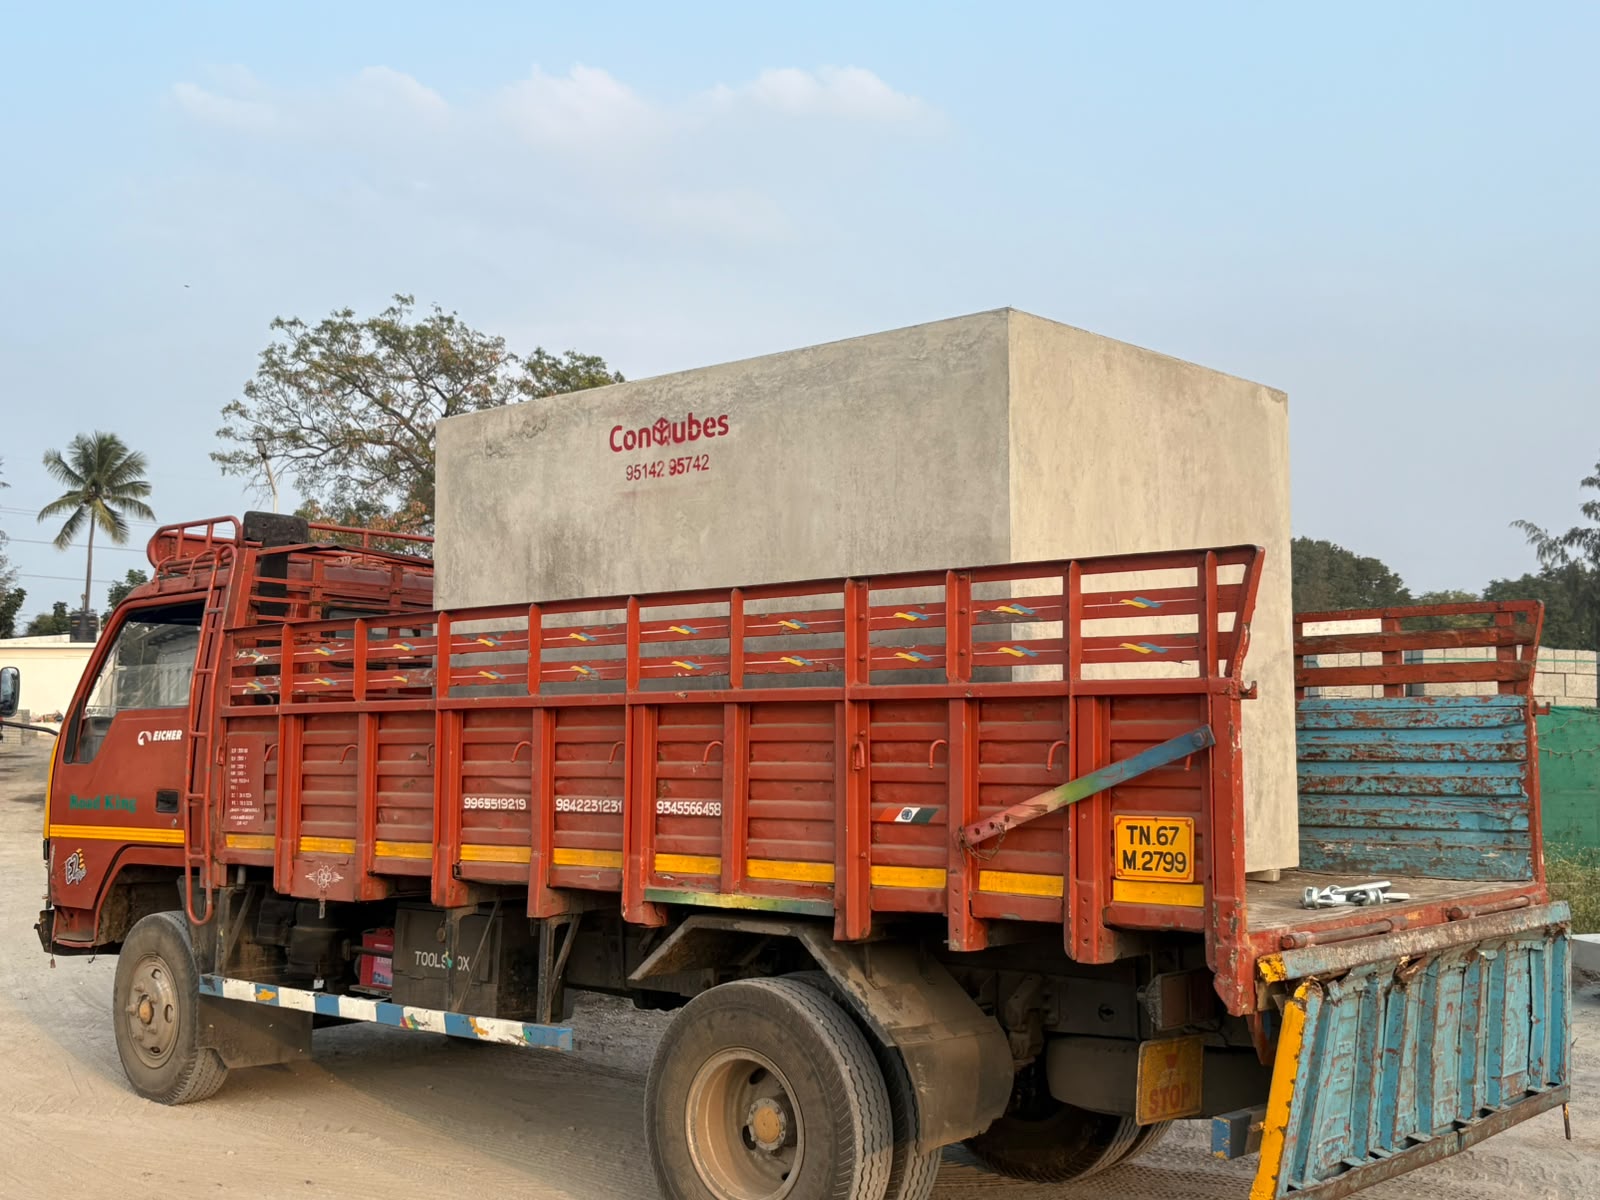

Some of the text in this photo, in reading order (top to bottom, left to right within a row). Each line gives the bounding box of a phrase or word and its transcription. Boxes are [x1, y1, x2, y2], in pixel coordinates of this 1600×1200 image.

[626, 454, 709, 481] 95142 95742
[153, 730, 182, 742] EICHER
[463, 797, 527, 810] 9965519219
[555, 798, 623, 813] 9842231231
[656, 801, 722, 816] 9345566458
